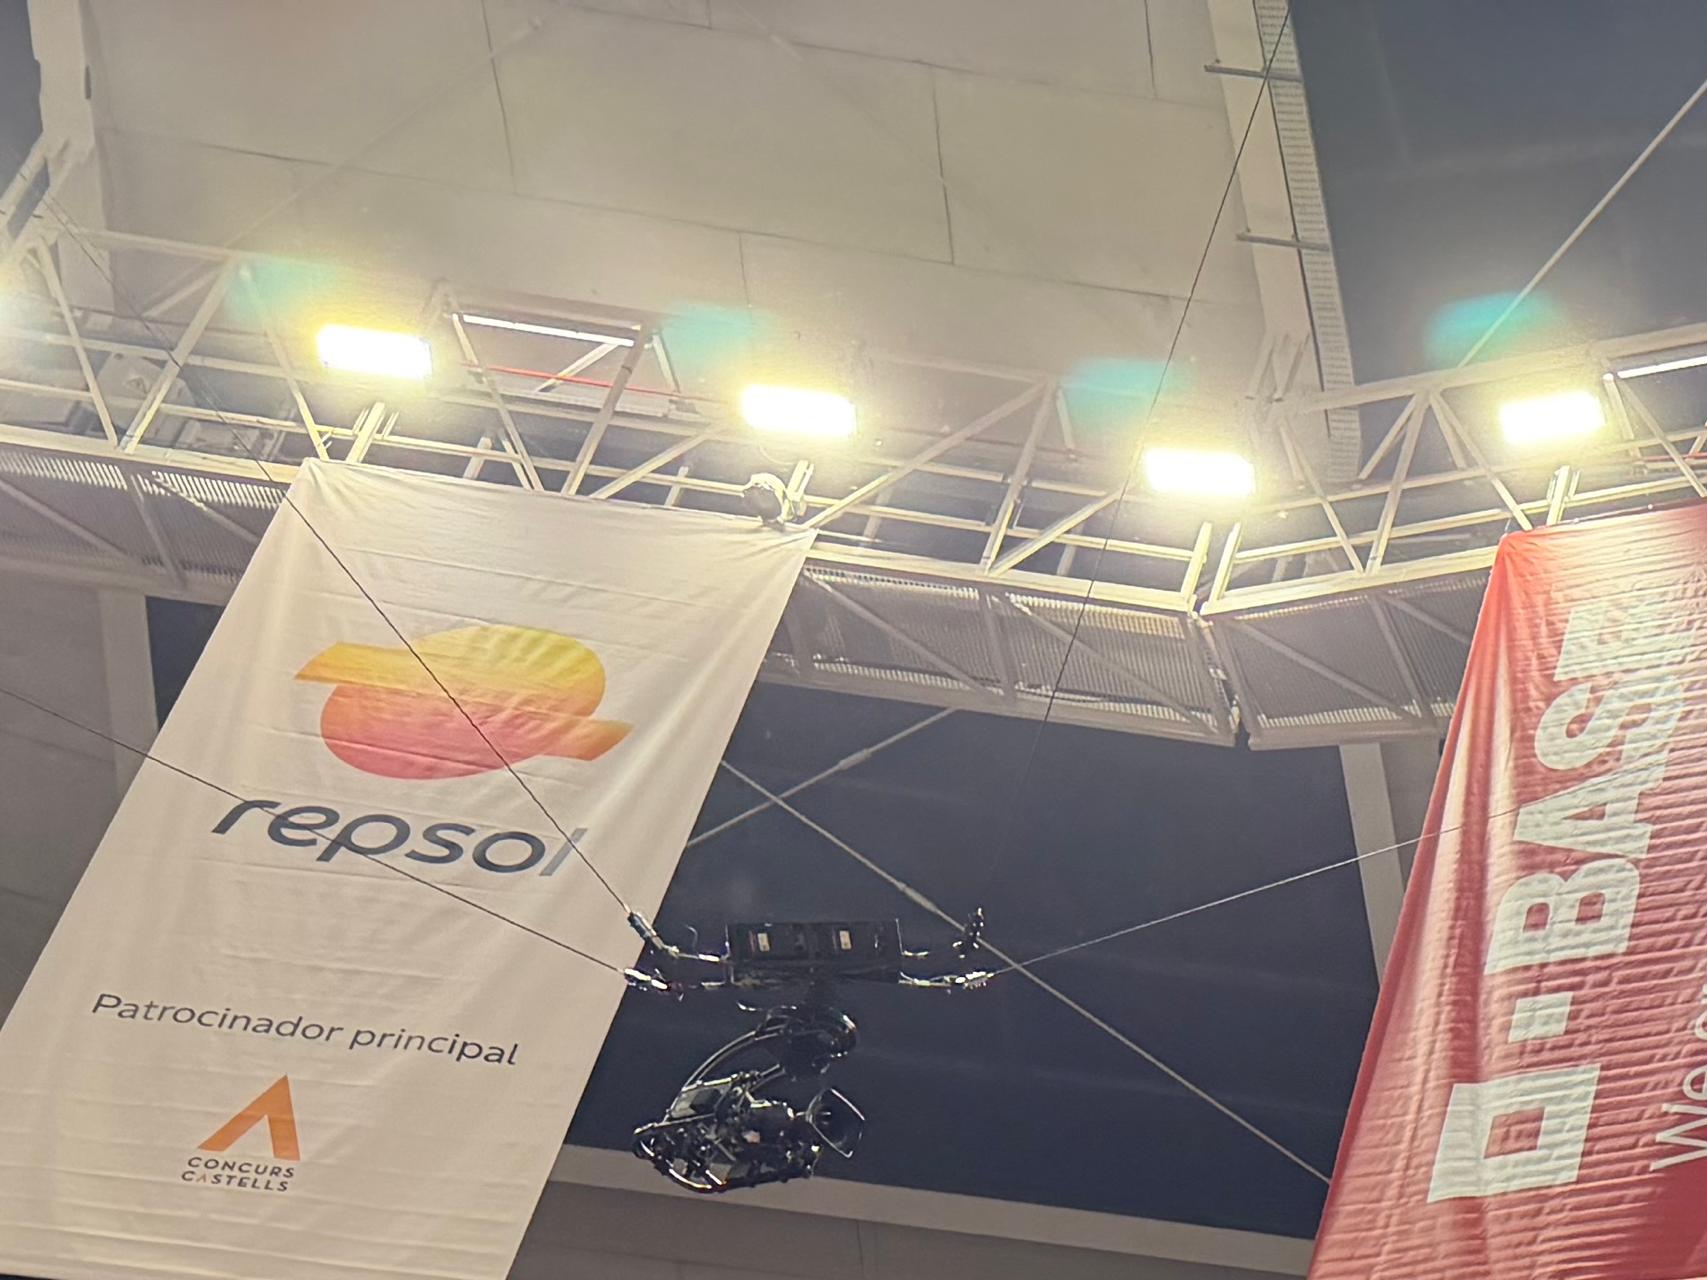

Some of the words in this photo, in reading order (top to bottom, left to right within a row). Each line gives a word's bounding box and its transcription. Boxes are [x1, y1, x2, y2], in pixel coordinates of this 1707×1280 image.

[1485, 601, 1697, 976] BASF
[211, 799, 588, 878] repsol
[92, 993, 345, 1043] Patrocinador
[348, 1025, 520, 1067] principal
[187, 1156, 295, 1179] CONCURS
